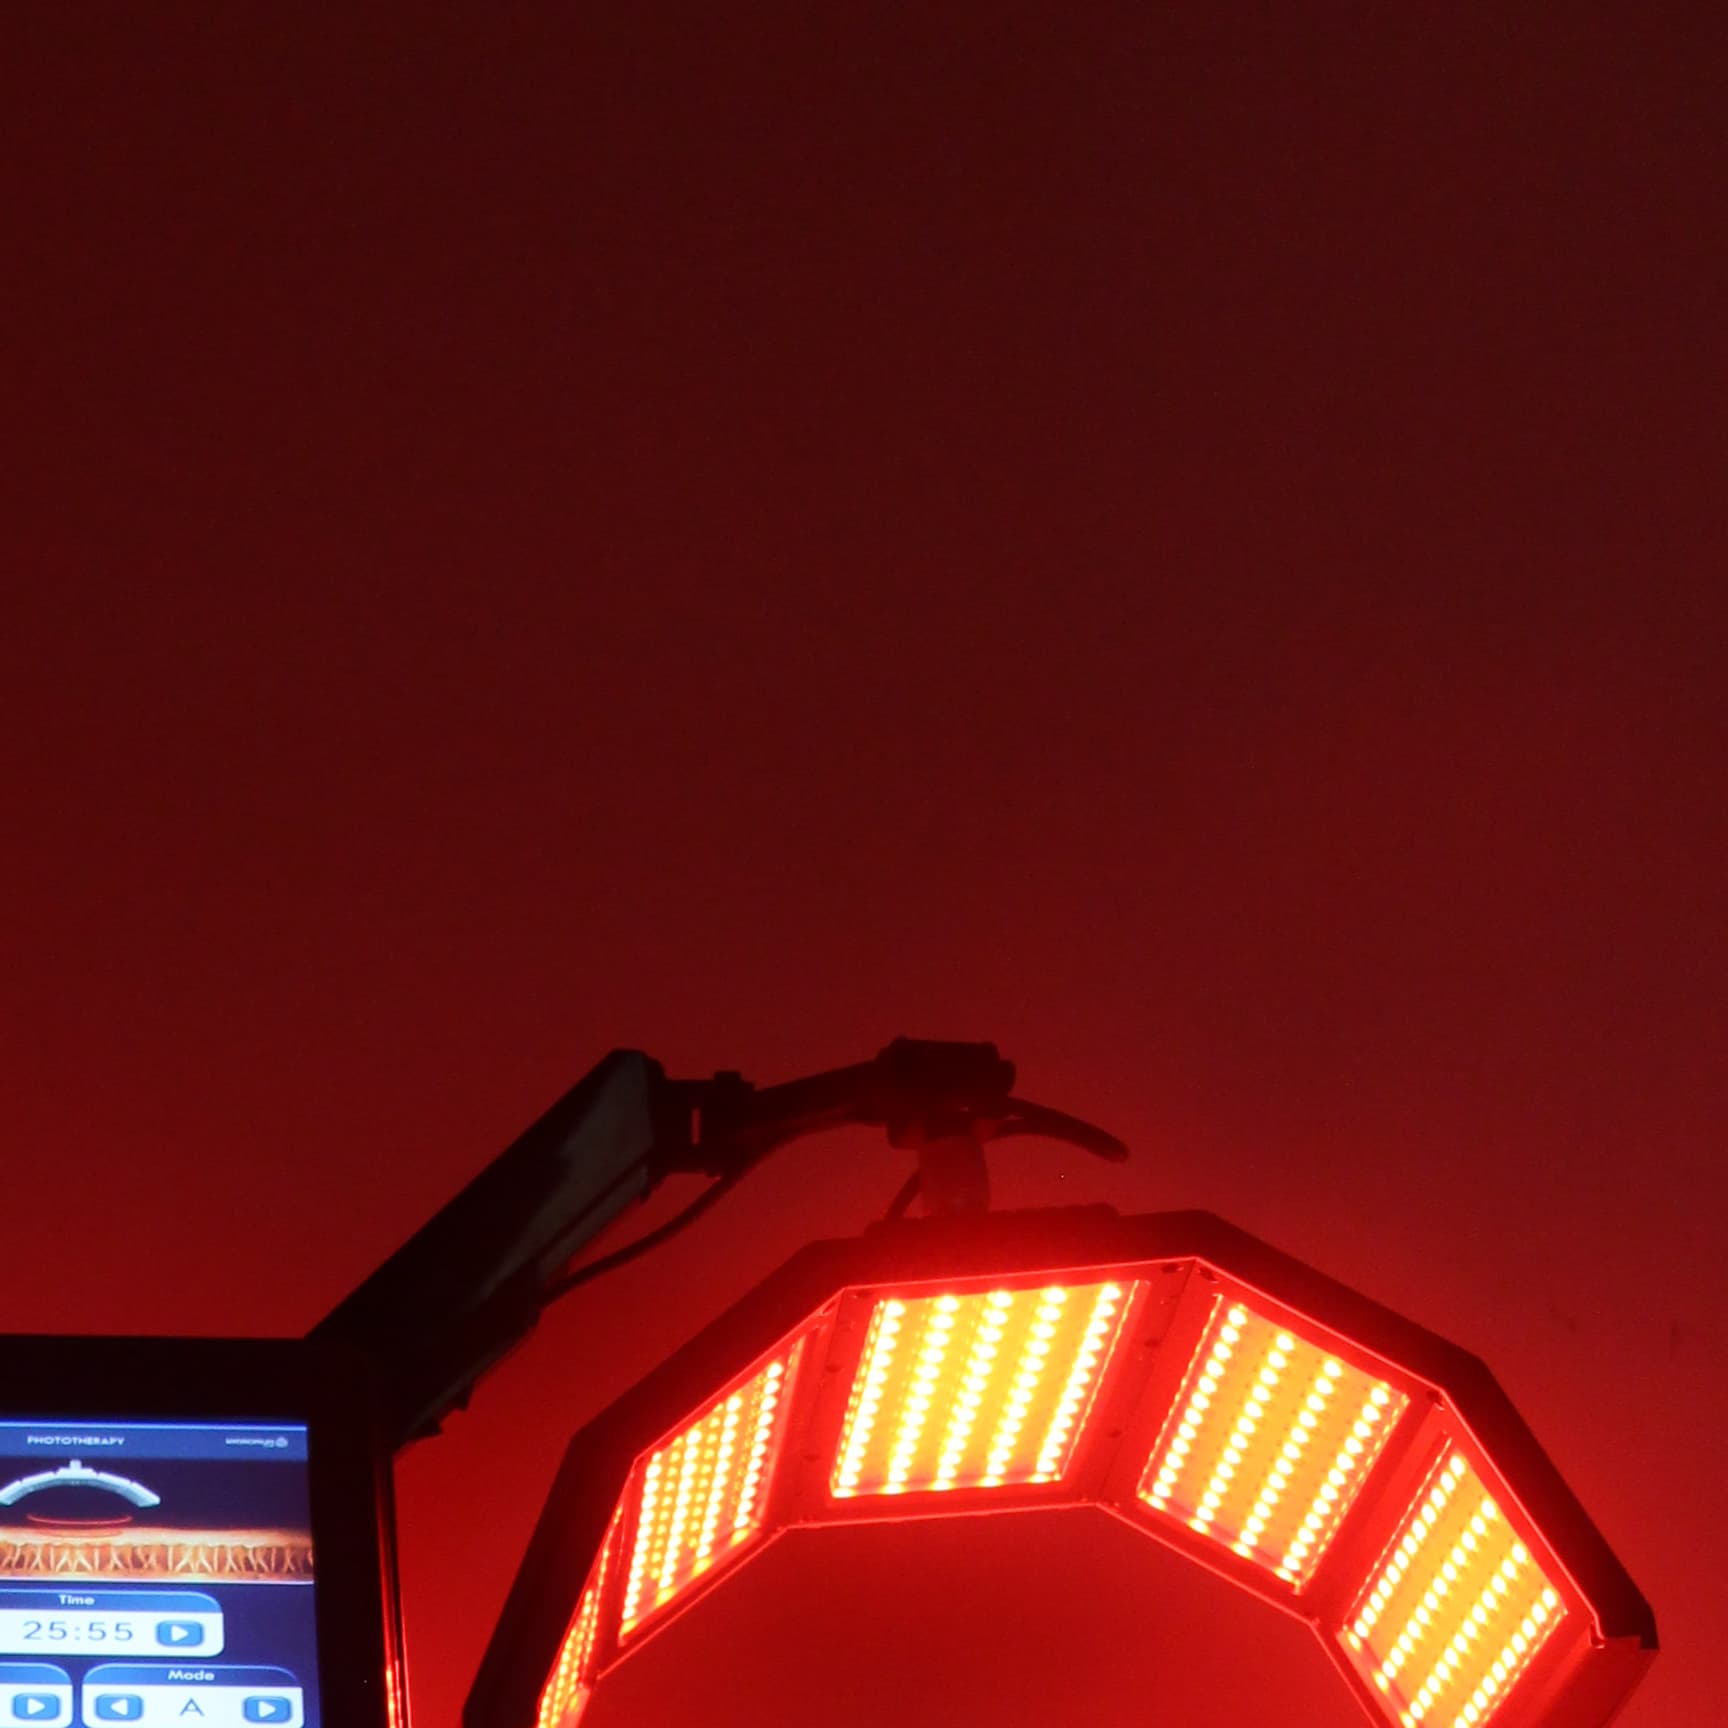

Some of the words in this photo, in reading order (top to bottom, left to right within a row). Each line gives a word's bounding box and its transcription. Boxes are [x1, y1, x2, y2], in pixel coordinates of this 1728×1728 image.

[27, 1435, 125, 1446] PHOTOTHERAPY
[59, 1594, 95, 1606] Time
[23, 1620, 134, 1642] 25:55
[168, 1668, 215, 1682] Mode
[180, 1698, 205, 1718] A
